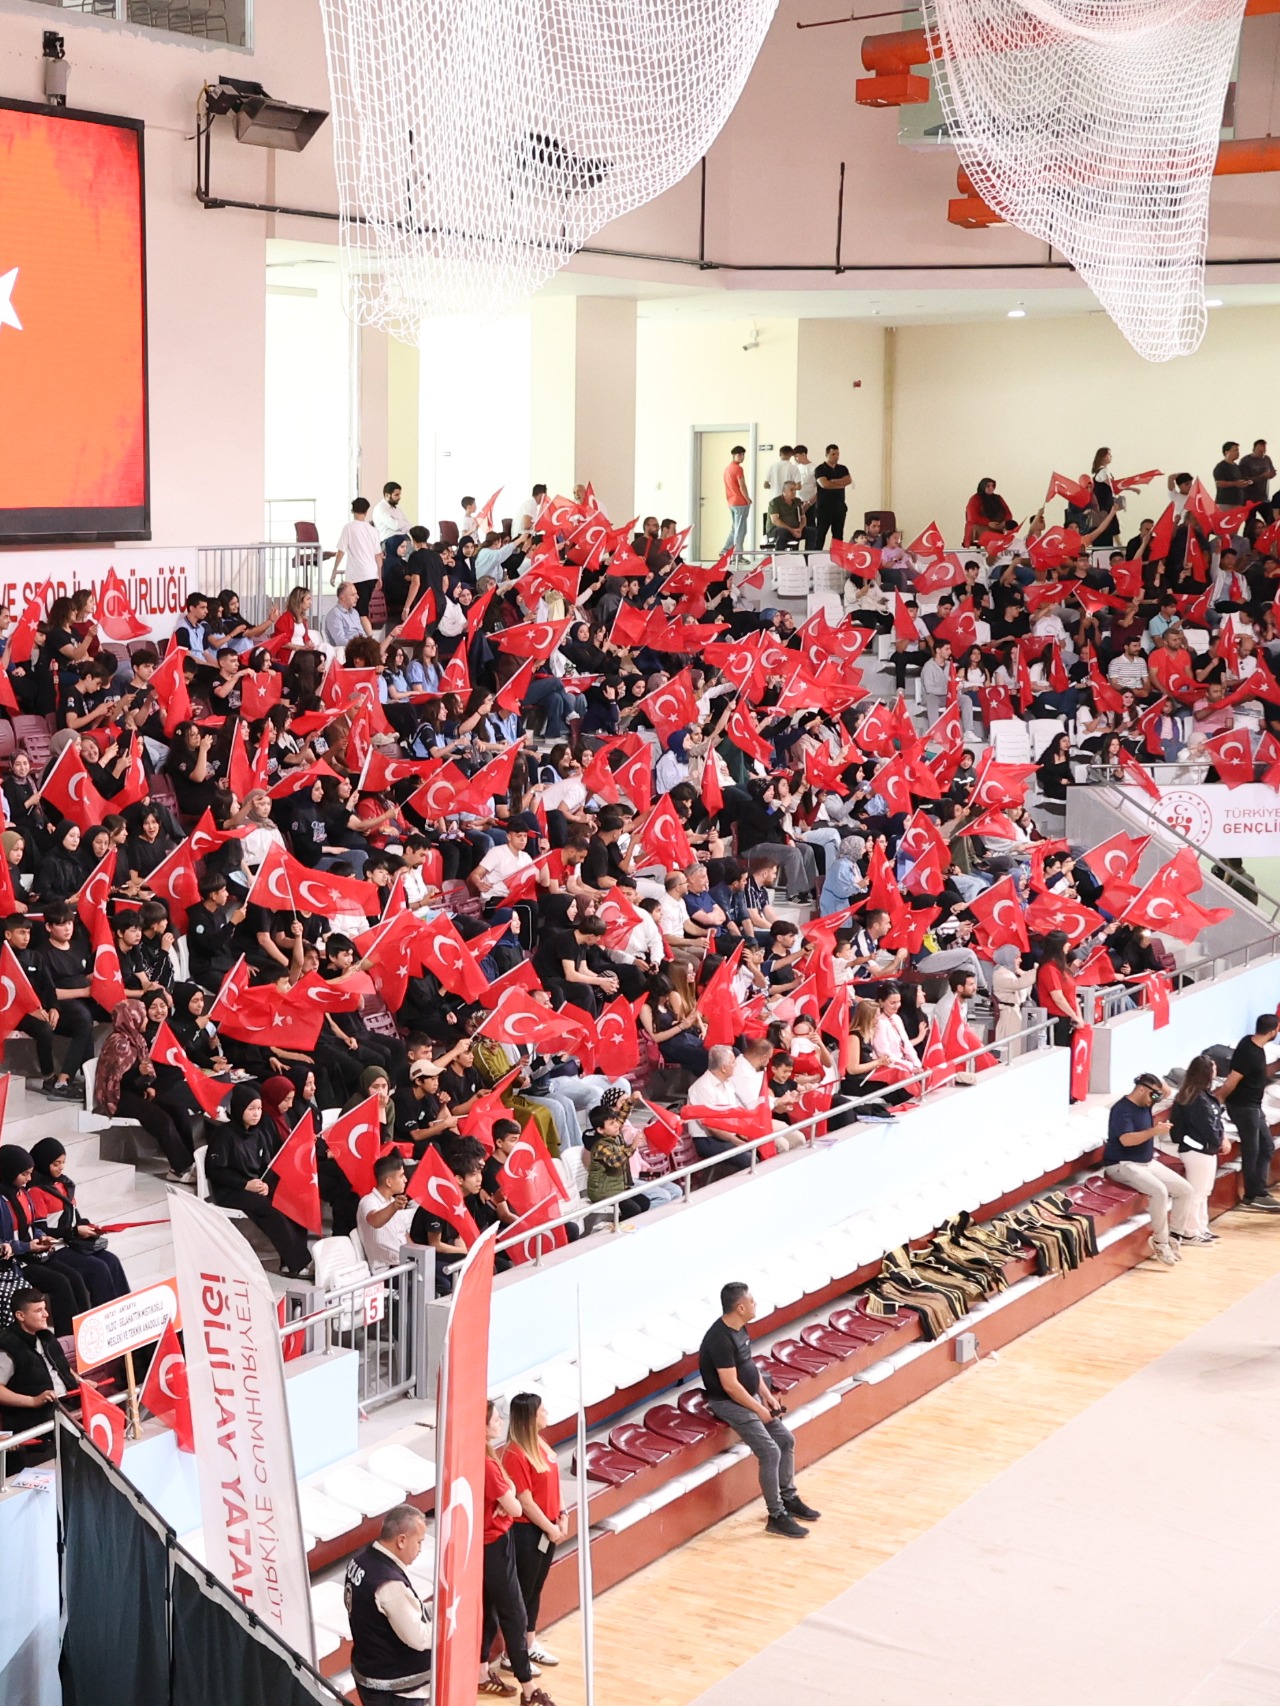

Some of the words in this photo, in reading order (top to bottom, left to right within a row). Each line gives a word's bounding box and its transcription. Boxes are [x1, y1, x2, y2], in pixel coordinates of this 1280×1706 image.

[1223, 806, 1280, 819] TÜRKİYE
[1223, 819, 1280, 835] GENÇLİ
[370, 1297, 378, 1320] 5
